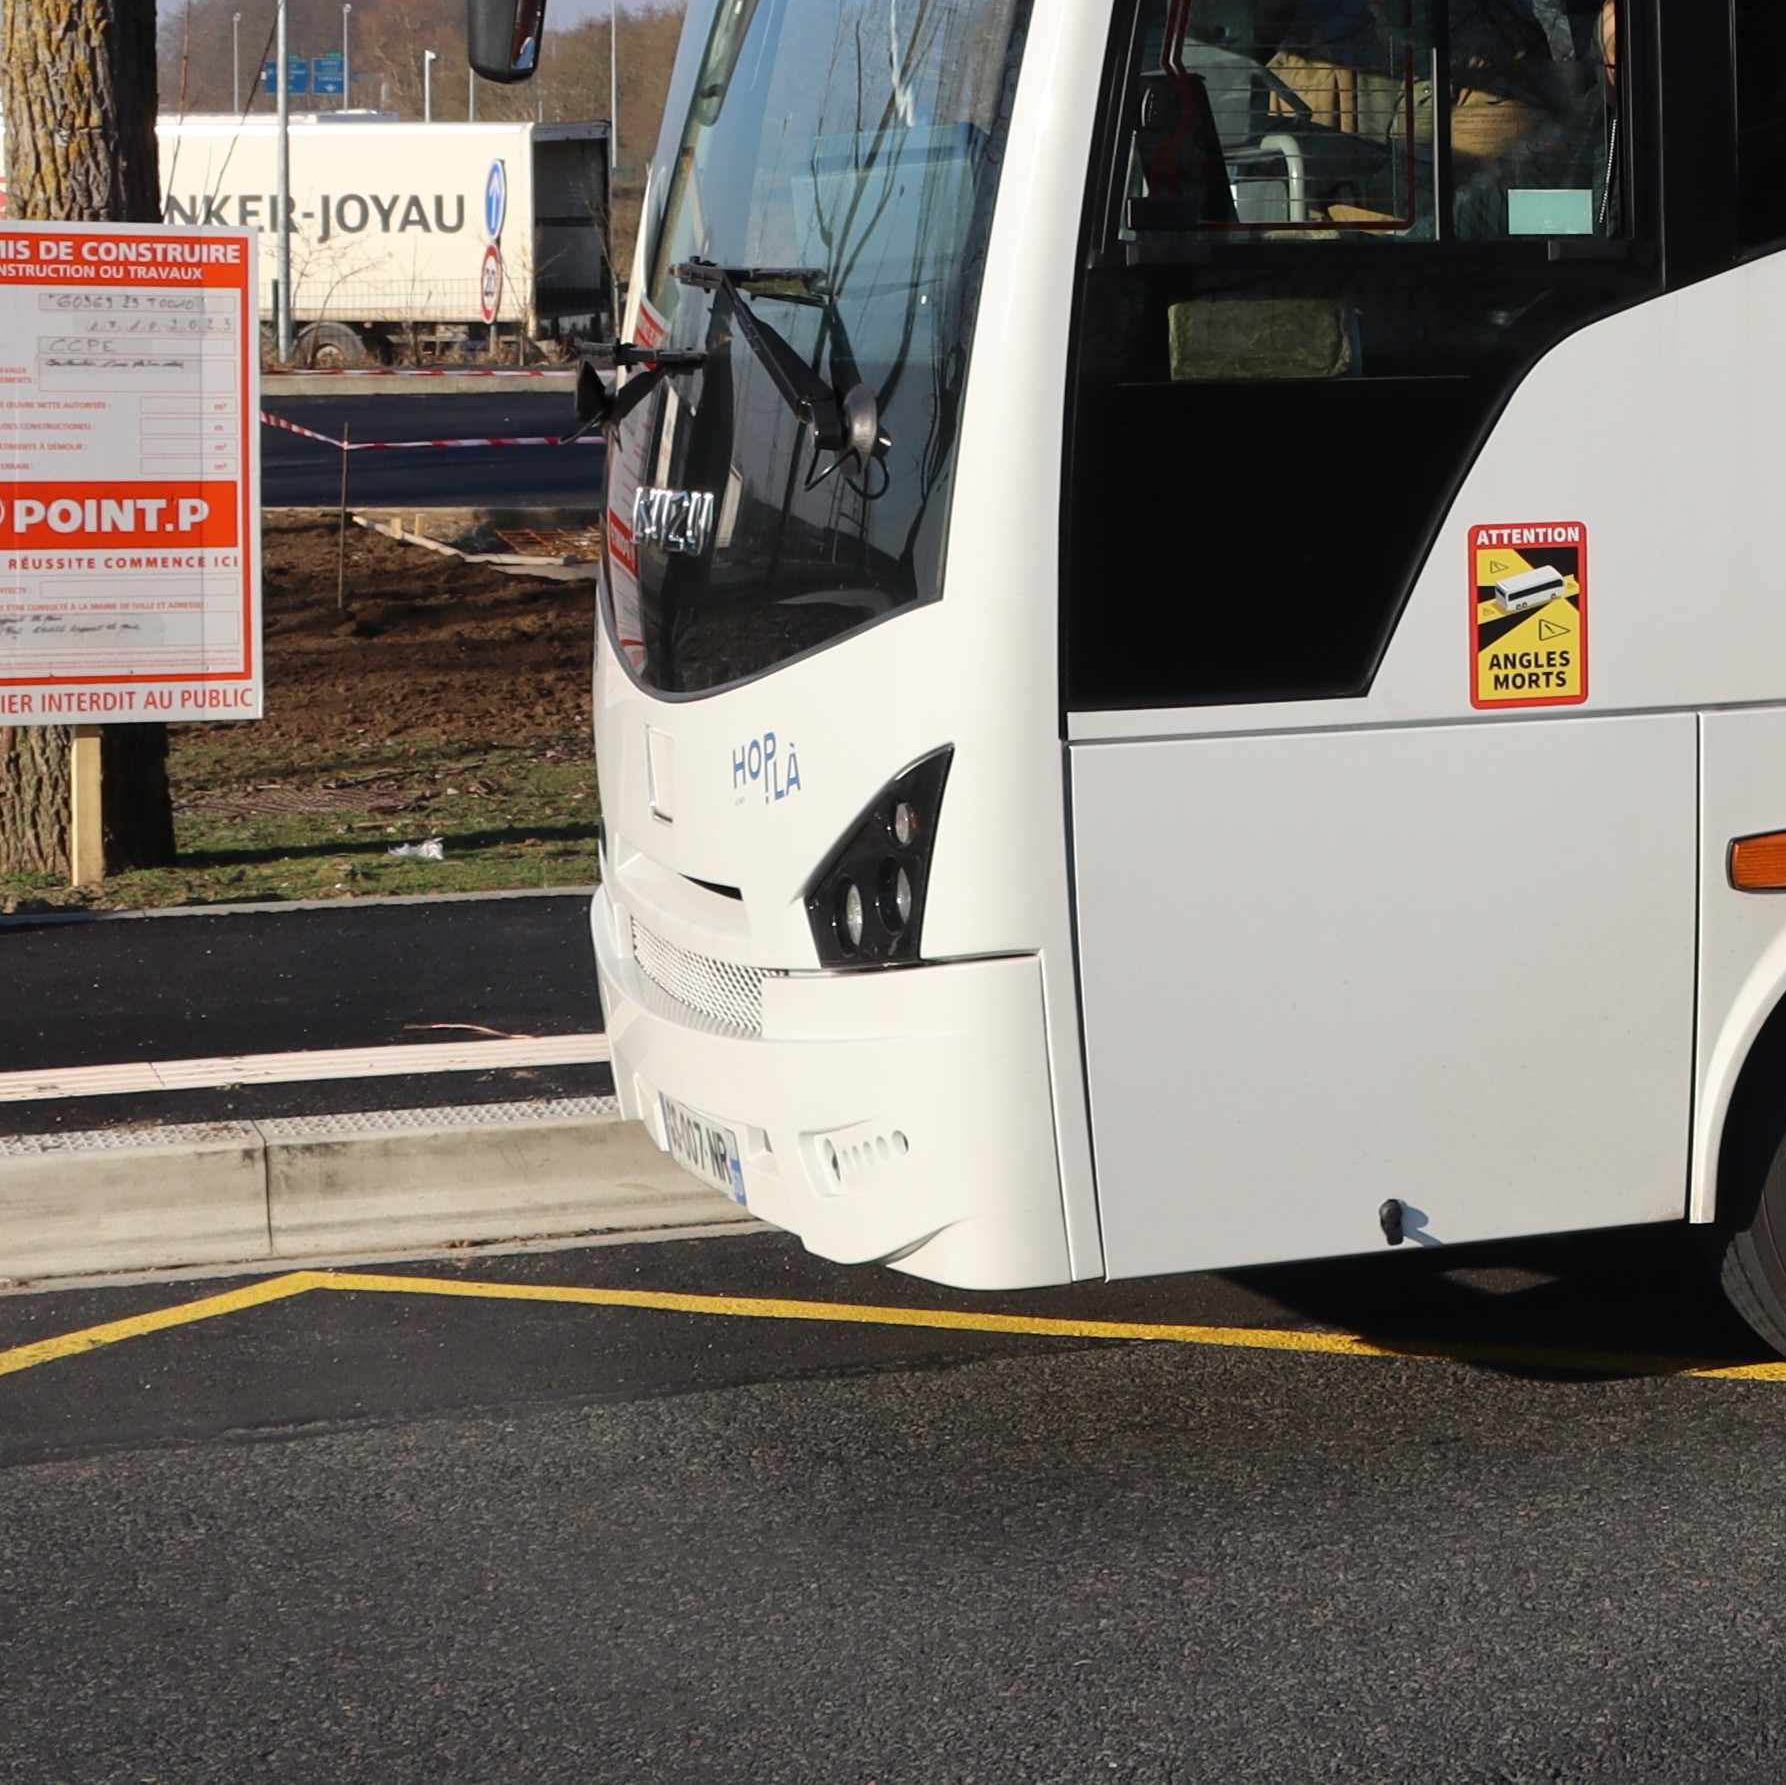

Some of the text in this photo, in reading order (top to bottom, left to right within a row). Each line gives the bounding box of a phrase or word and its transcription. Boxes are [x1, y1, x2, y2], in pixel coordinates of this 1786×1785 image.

[39, 240, 73, 261] DE
[81, 242, 241, 264] CONSTRUIRE
[100, 265, 124, 279] OU
[128, 266, 203, 281] TRAVAUX
[49, 338, 117, 353] CCPE
[13, 497, 211, 534] POINT.P
[1476, 526, 1581, 546] ATTENTION
[8, 554, 239, 571] RÉUSSITE COMMENCE ICI
[1488, 649, 1571, 671] ANGLES
[1493, 670, 1568, 691] MORTS
[41, 690, 137, 713] INTERDIT
[143, 690, 173, 710] AU
[180, 687, 254, 708] PUBLIC
